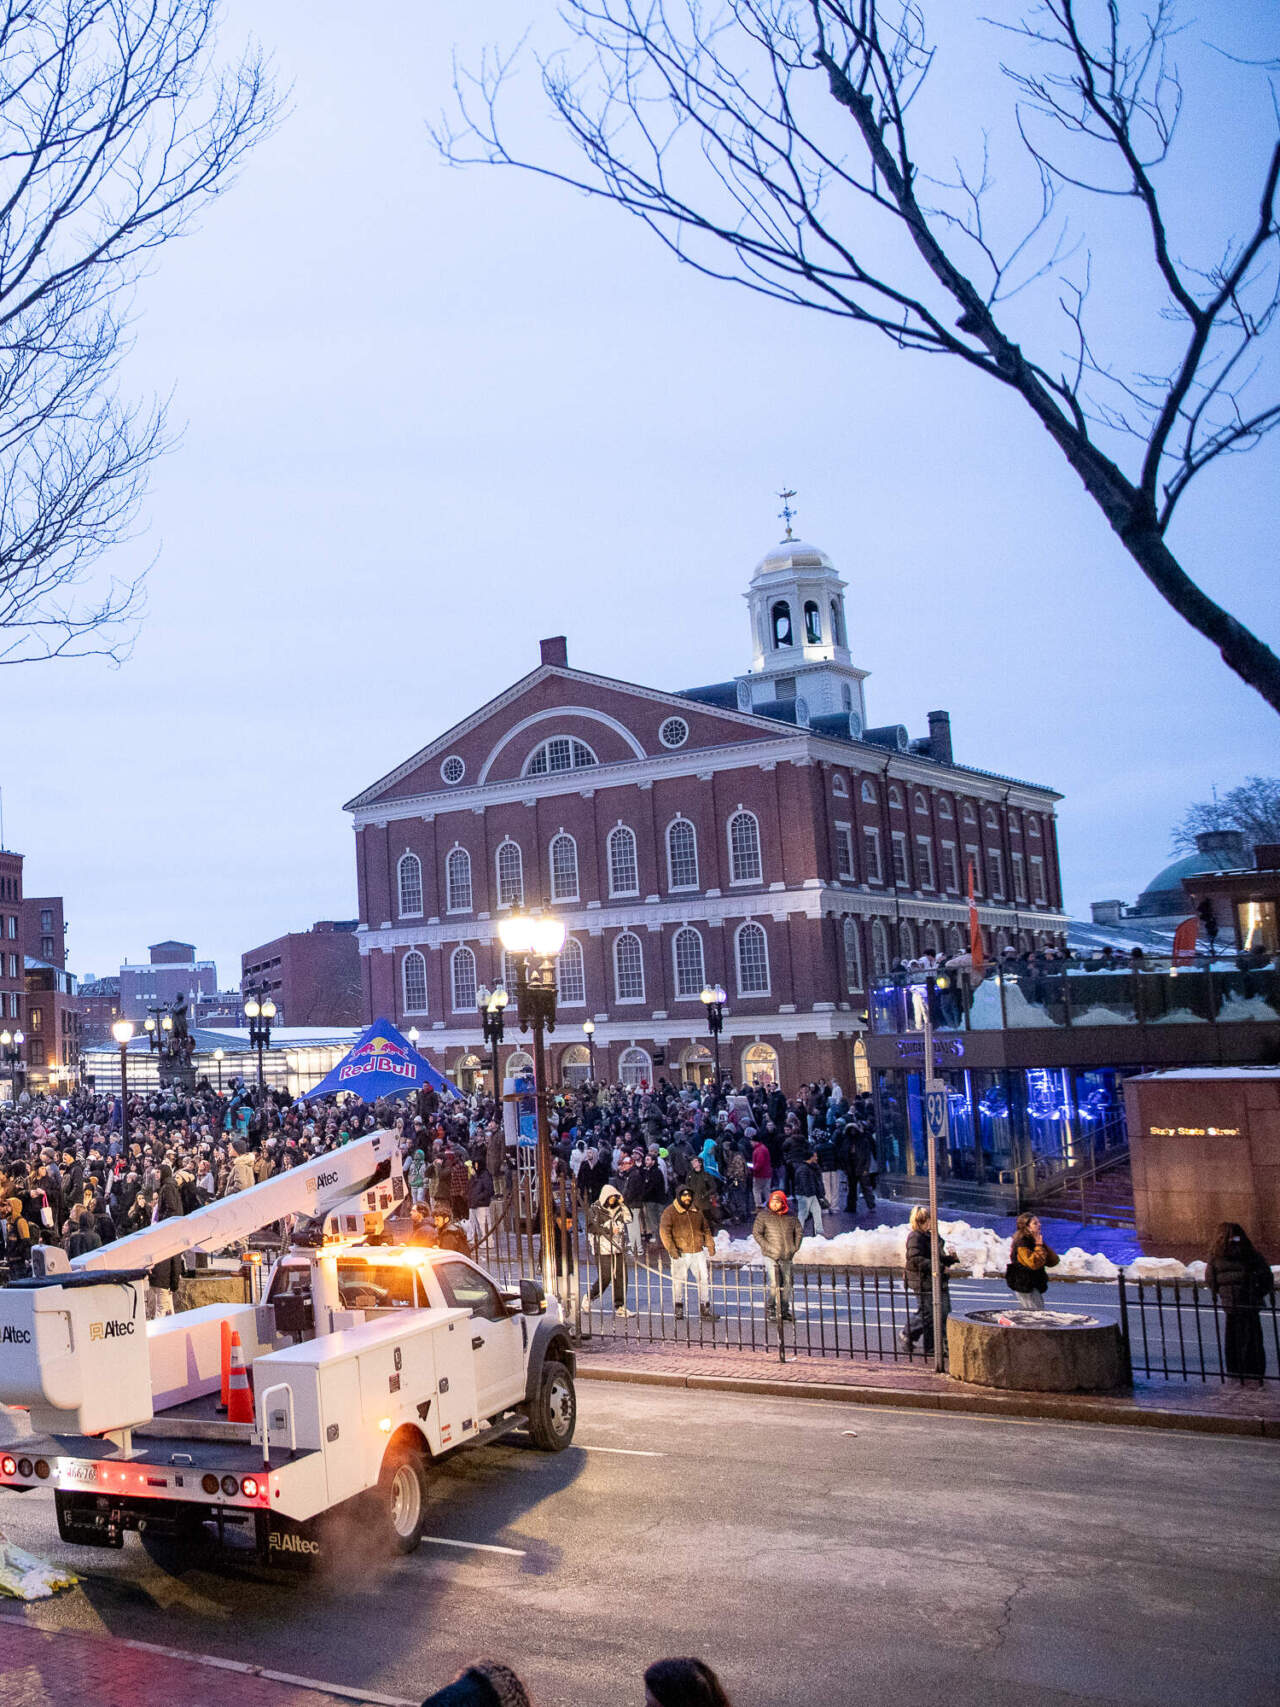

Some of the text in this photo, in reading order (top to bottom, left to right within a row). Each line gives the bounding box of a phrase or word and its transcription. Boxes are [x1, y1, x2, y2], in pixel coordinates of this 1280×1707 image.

[339, 1056, 417, 1081] Red Bull
[928, 1095, 943, 1125] 93
[1177, 1127, 1205, 1136] State
[1207, 1127, 1240, 1136] Street
[317, 1172, 338, 1190] Altec
[2, 1326, 31, 1343] Altec
[104, 1321, 135, 1339] Altec
[282, 1534, 320, 1554] Altec
